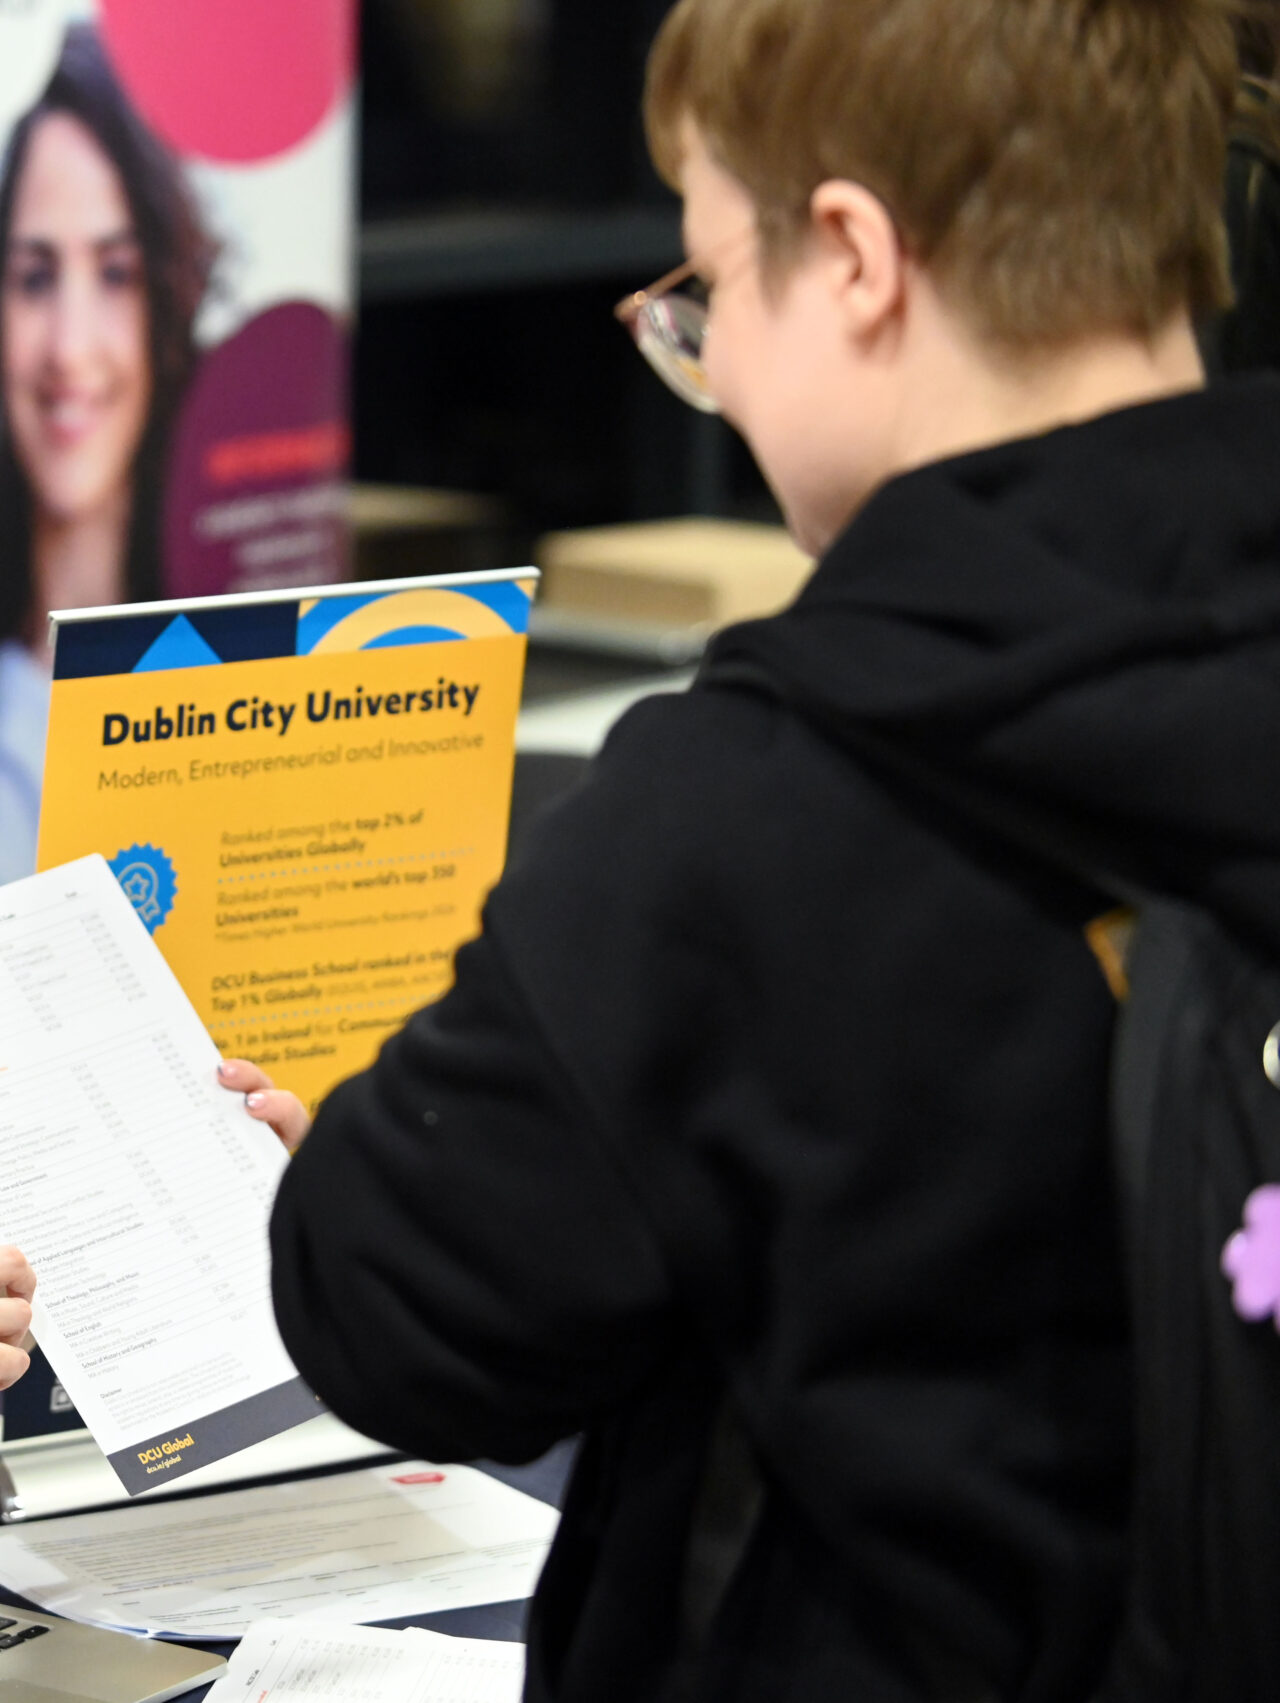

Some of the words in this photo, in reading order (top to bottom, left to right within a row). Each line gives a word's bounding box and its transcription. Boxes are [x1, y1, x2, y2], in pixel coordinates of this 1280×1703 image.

[102, 703, 216, 746] Dublin
[226, 697, 296, 736] City
[307, 677, 480, 724] University
[98, 757, 184, 791] Modern,
[190, 747, 342, 782] Entrepreneurial
[347, 744, 384, 763] and
[389, 732, 484, 758] Innovative
[355, 815, 381, 832] top
[407, 808, 425, 824] of
[220, 844, 303, 868] Universities
[306, 836, 365, 858] Globally
[215, 904, 299, 926] Universities
[211, 974, 246, 991] DCU
[249, 966, 308, 985] Business
[312, 959, 358, 977] School
[362, 952, 411, 970] ranked
[211, 995, 237, 1012] Top
[264, 983, 322, 1005] Globally
[261, 1025, 312, 1042] Ireland
[284, 1041, 336, 1060] Studies
[81, 1359, 97, 1368] School
[137, 1446, 163, 1464] DCU
[160, 1433, 195, 1455] Global
[145, 1454, 182, 1475] dcu.ie/global
